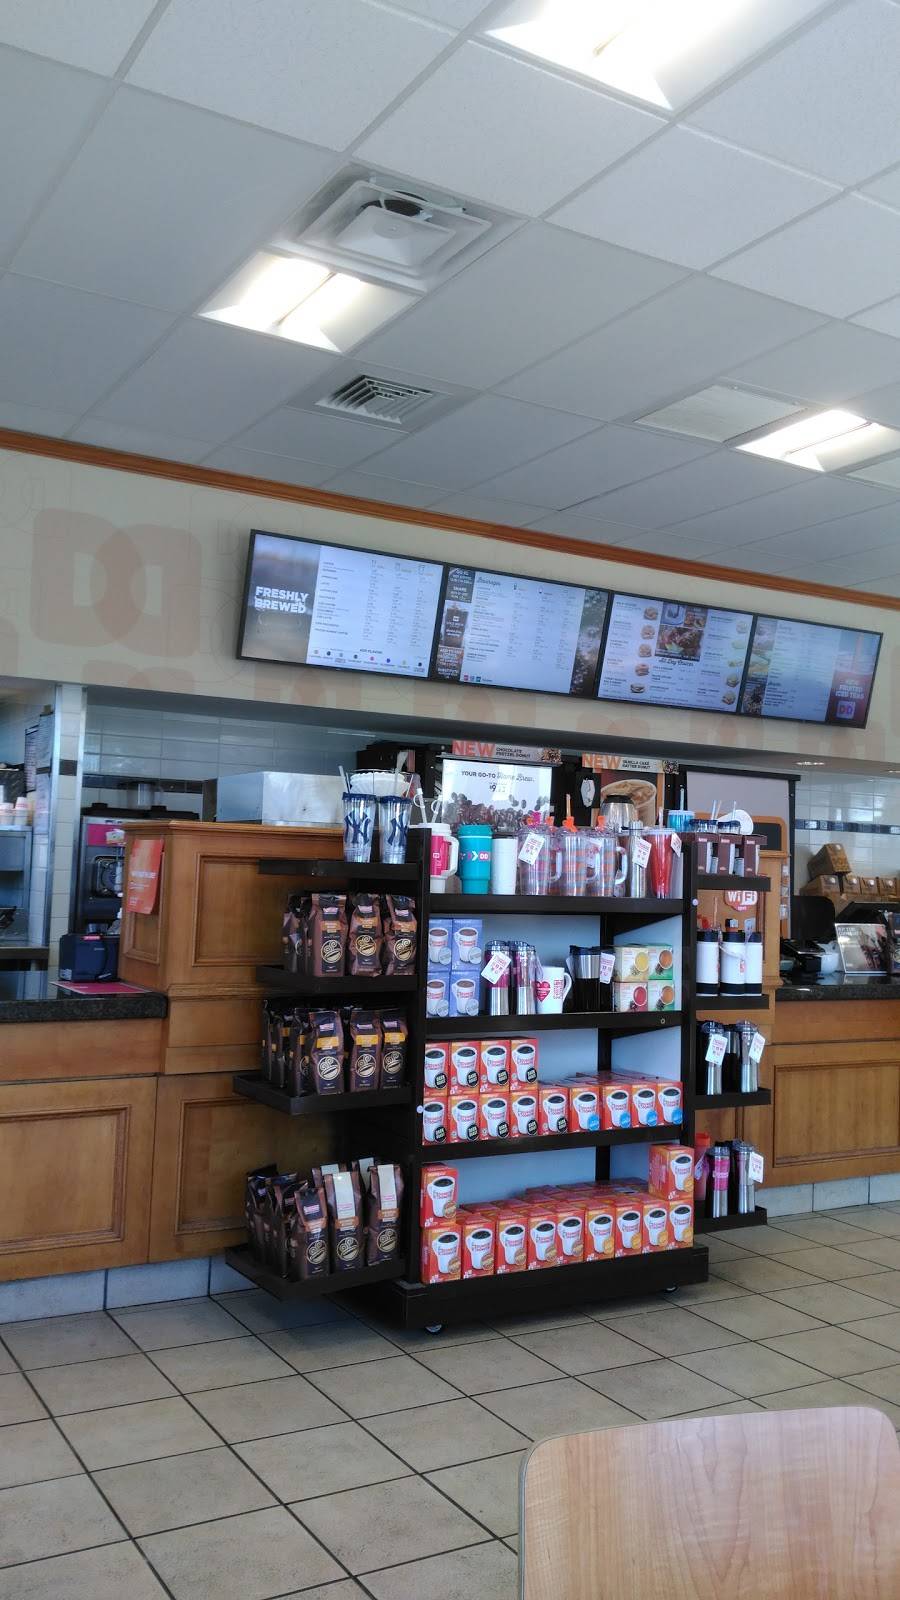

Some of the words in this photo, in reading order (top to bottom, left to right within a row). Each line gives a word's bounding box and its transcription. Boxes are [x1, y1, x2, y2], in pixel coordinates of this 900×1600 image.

[255, 586, 309, 602] FRESHLY
[254, 599, 307, 614] BREWED
[452, 740, 495, 758] NEW
[582, 752, 620, 768] NEW
[728, 890, 756, 905] WiFi
